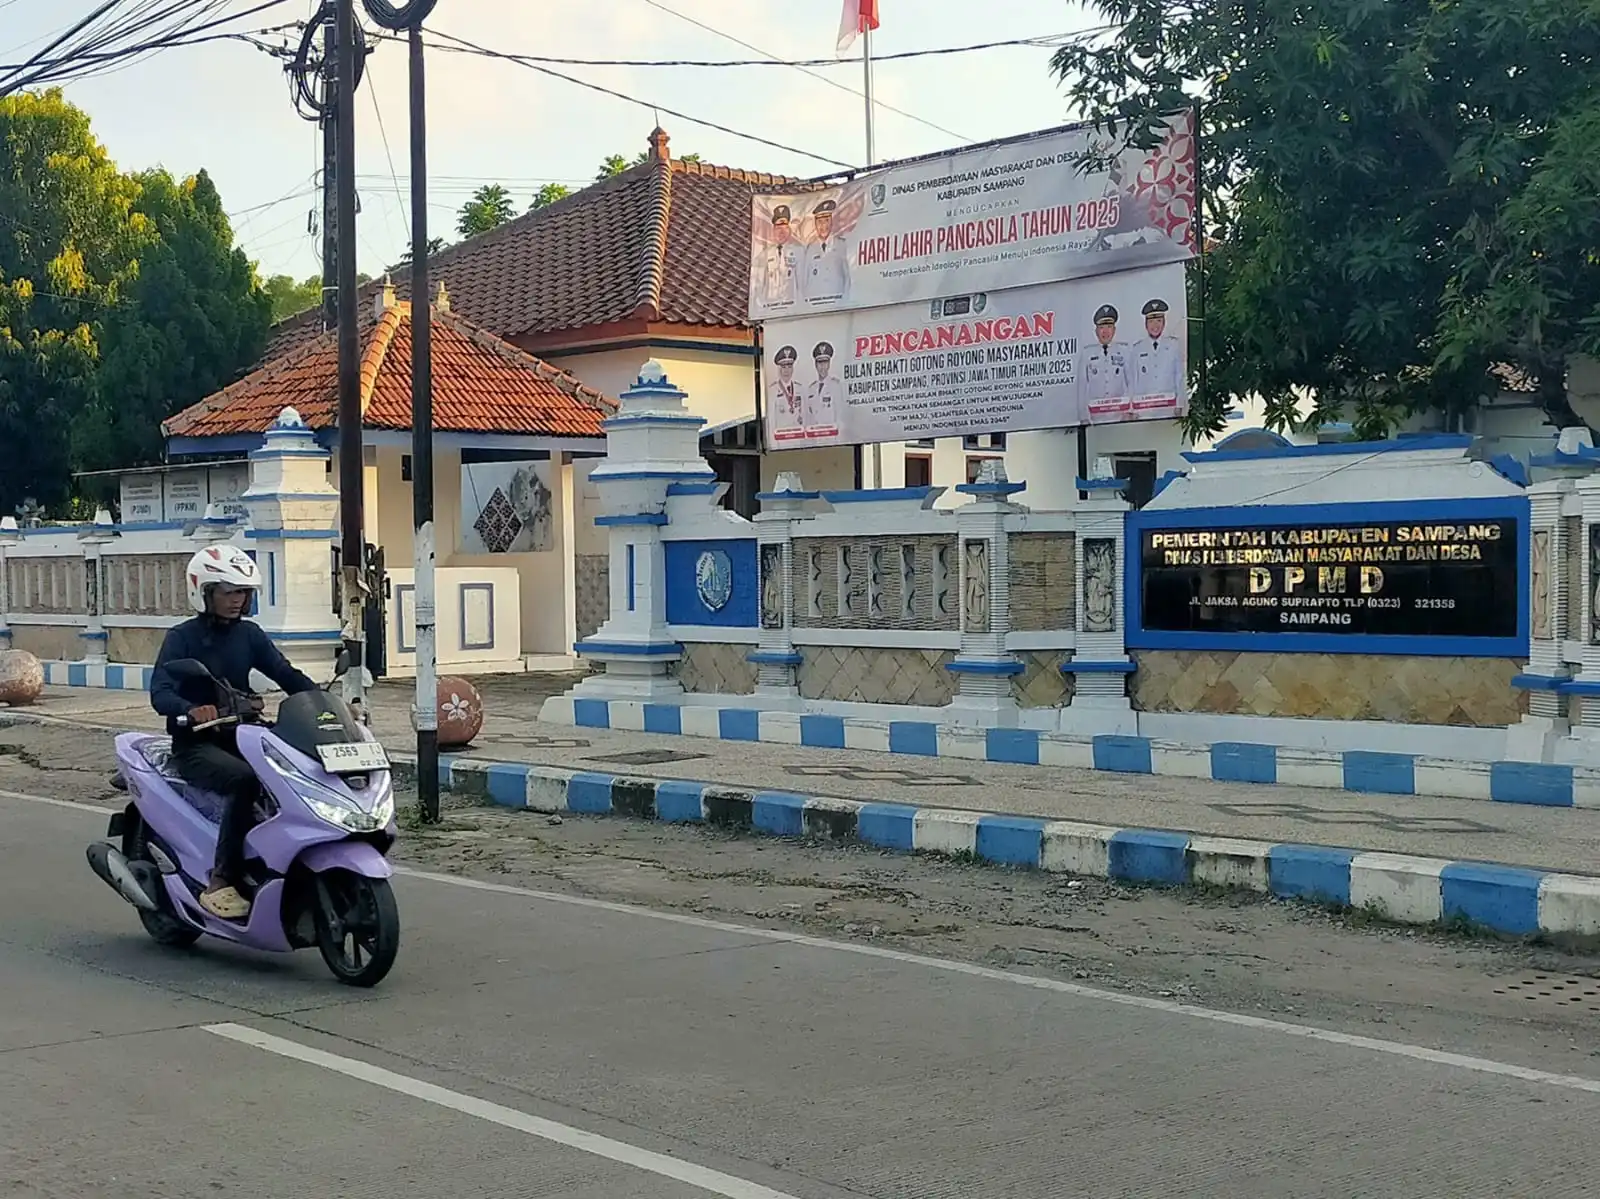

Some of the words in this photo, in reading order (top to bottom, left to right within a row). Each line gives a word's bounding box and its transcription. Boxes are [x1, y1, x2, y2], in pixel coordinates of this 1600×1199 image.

[892, 183, 916, 196] DINAS
[917, 170, 979, 192] PEMBERDAYAAN
[980, 159, 1034, 178] MASYARAKAT
[1035, 155, 1055, 168] DAN
[1056, 151, 1080, 164] DESA
[937, 184, 981, 201] KABUPATEN
[983, 176, 1025, 192] SAMPANG
[946, 199, 1020, 217] MENGUCAPKAN
[858, 235, 890, 266] HARI
[893, 228, 933, 261] LAHIR
[936, 215, 1018, 254] PANCASILA
[1021, 204, 1072, 240] TAHUN
[1076, 196, 1119, 231] 2025
[931, 257, 962, 271] Ideologi
[963, 252, 999, 266] Pancasila
[1000, 249, 1029, 261] Menuju
[854, 311, 1054, 358] PENCANANGAN
[844, 361, 873, 379] BULAN
[874, 358, 908, 376] BHAKTI
[910, 353, 945, 372] GOTONG
[946, 348, 984, 368] ROYONG
[987, 340, 1054, 363] MASYARAKAT
[1056, 338, 1077, 356] XXII
[848, 379, 890, 396] KABUPATEN
[930, 370, 966, 387] PROVINSI
[967, 366, 990, 384] JAWA
[991, 364, 1017, 381] TIMUR
[1019, 361, 1048, 378] TAHUN
[1049, 359, 1072, 375] 2025
[876, 393, 914, 402] MOMENTUM
[915, 391, 937, 399] BULAN
[938, 388, 962, 397] BHAKTI
[964, 384, 992, 395] GOTONG
[994, 382, 1024, 391] ROYONG
[1026, 376, 1075, 388] MASYARAKAT
[888, 403, 928, 412] TINGKATKAN
[929, 398, 965, 408] SEMANGAT
[966, 397, 989, 405] UNTUK
[991, 391, 1043, 402] MEWUJUDKAN
[970, 407, 985, 415] DAN
[986, 403, 1024, 413] MENDUNIA
[931, 420, 969, 429] INDONESIA
[970, 418, 989, 426] EMAS
[1152, 530, 1266, 549] PEMERINTAH
[1271, 527, 1389, 546] KABUPATEN
[1396, 524, 1502, 543] SAMPANG
[1307, 544, 1403, 563] MASYARAKAT
[1406, 544, 1438, 561] DAN
[1440, 543, 1482, 561] DESA
[1205, 597, 1238, 607] JAKSA
[1242, 597, 1279, 607] AGUNG
[1281, 597, 1340, 608] SUPRAPTO
[1344, 598, 1365, 608] TLP
[1367, 597, 1401, 609] (0323)
[1414, 599, 1456, 609] 321358
[1279, 612, 1352, 625] SAMPANG
